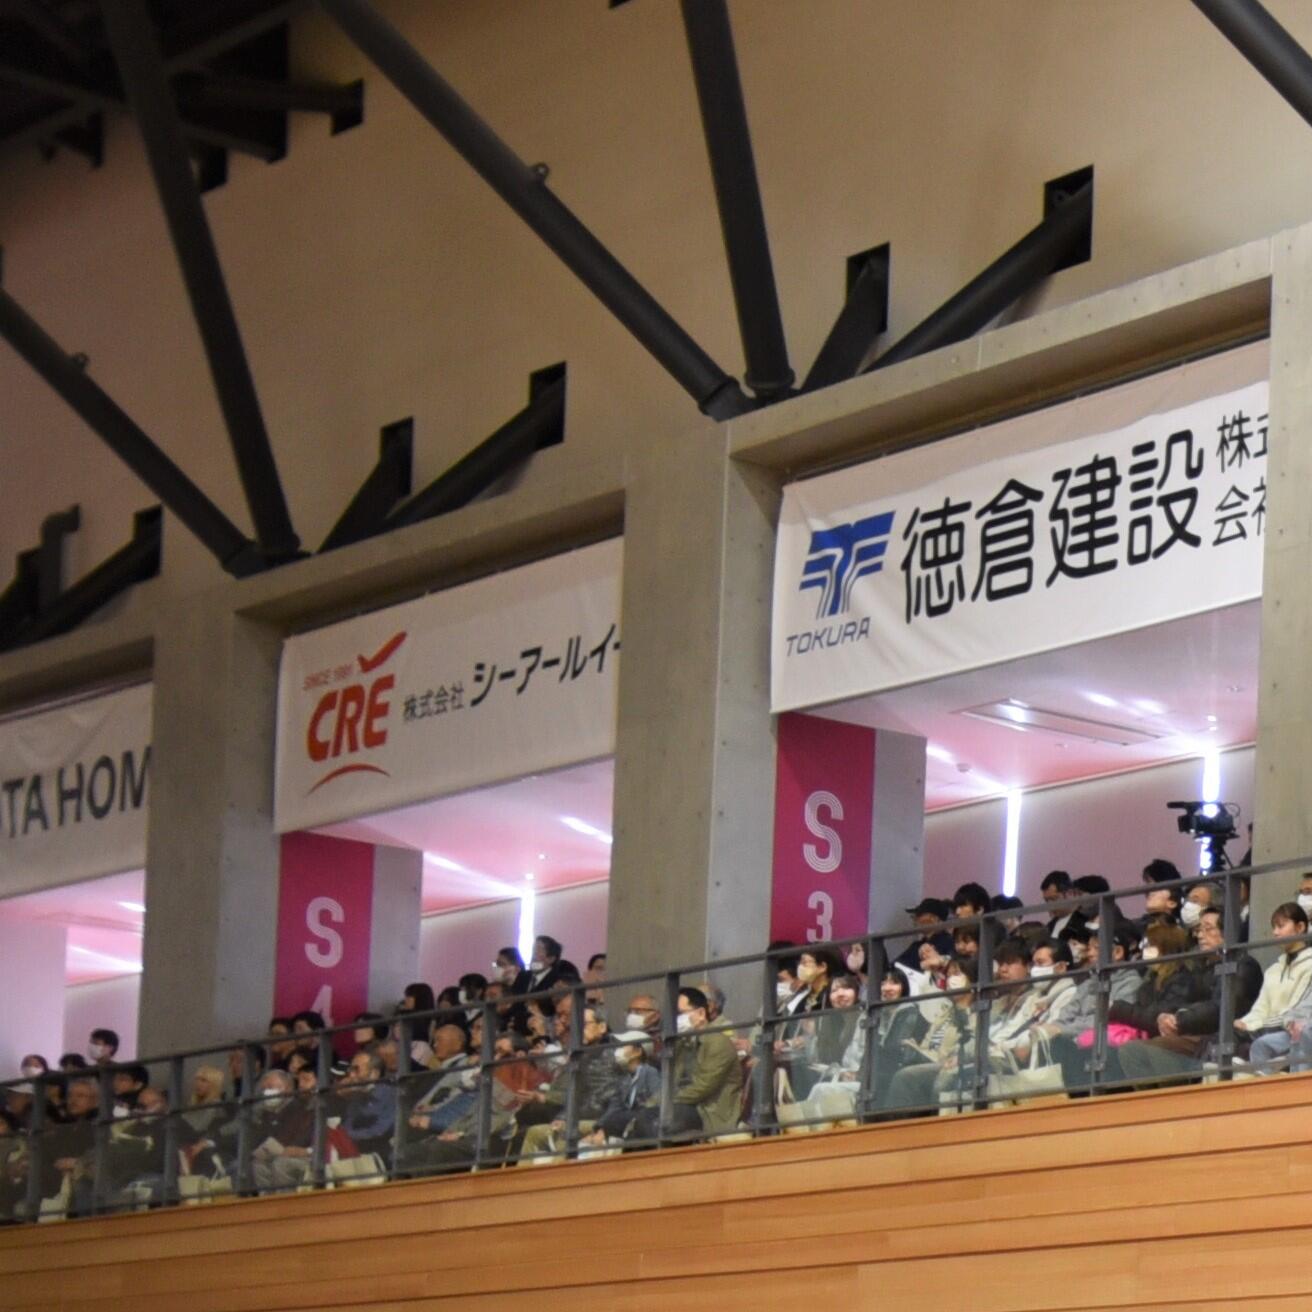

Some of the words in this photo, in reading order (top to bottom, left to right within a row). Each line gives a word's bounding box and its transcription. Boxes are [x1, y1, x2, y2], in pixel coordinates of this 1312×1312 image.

[900, 429, 1204, 625] 徳倉建設
[785, 616, 872, 658] TOKURA
[306, 673, 396, 763] CRE
[0, 773, 49, 838] TA
